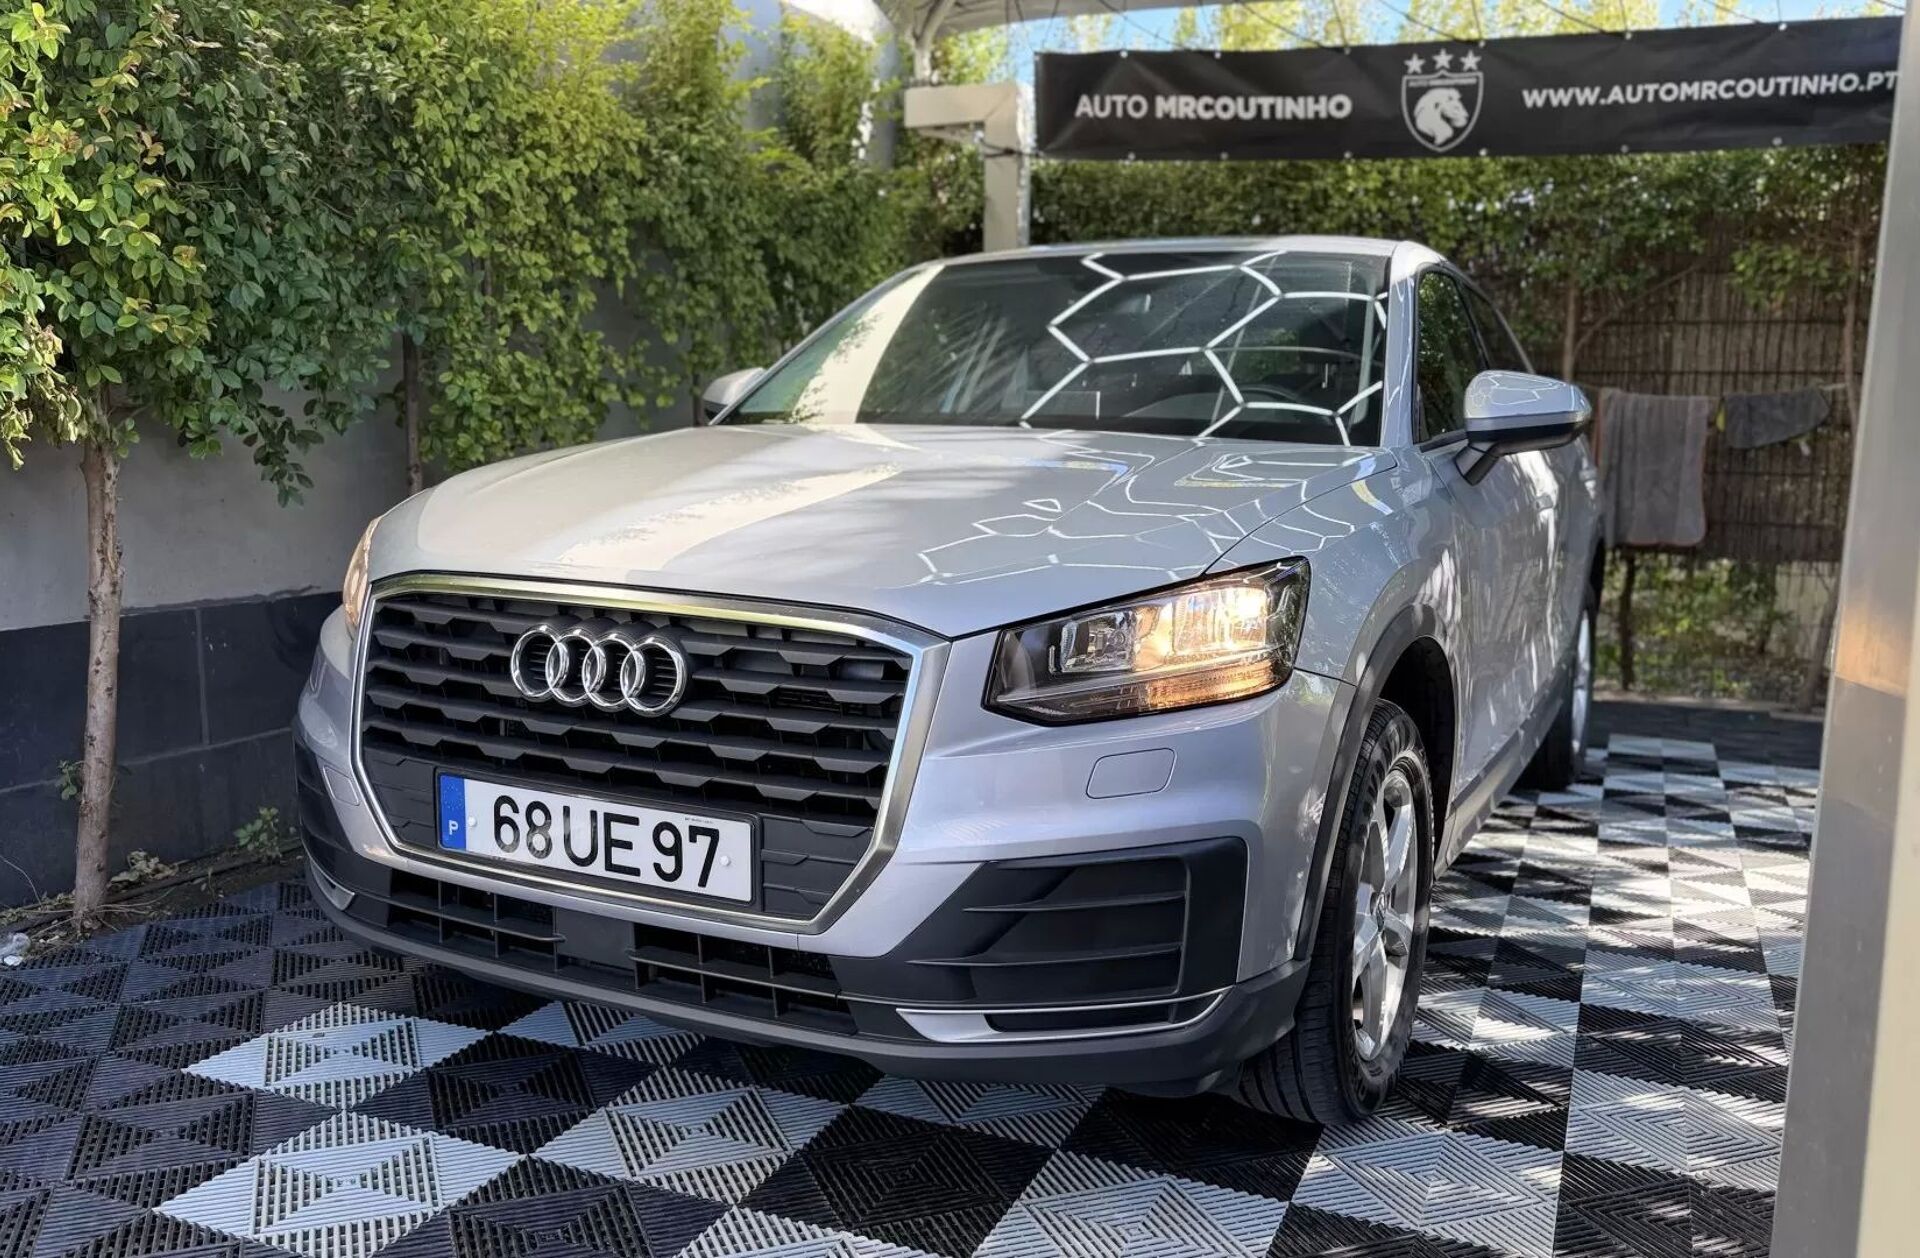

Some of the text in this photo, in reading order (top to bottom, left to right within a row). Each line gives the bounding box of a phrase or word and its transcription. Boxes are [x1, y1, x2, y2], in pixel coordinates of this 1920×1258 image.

[1521, 70, 1901, 108] WWW.AUTOMRCOUTINHO.PT
[1075, 93, 1353, 120] AUTO MRCOUTINHO
[448, 819, 459, 836] P
